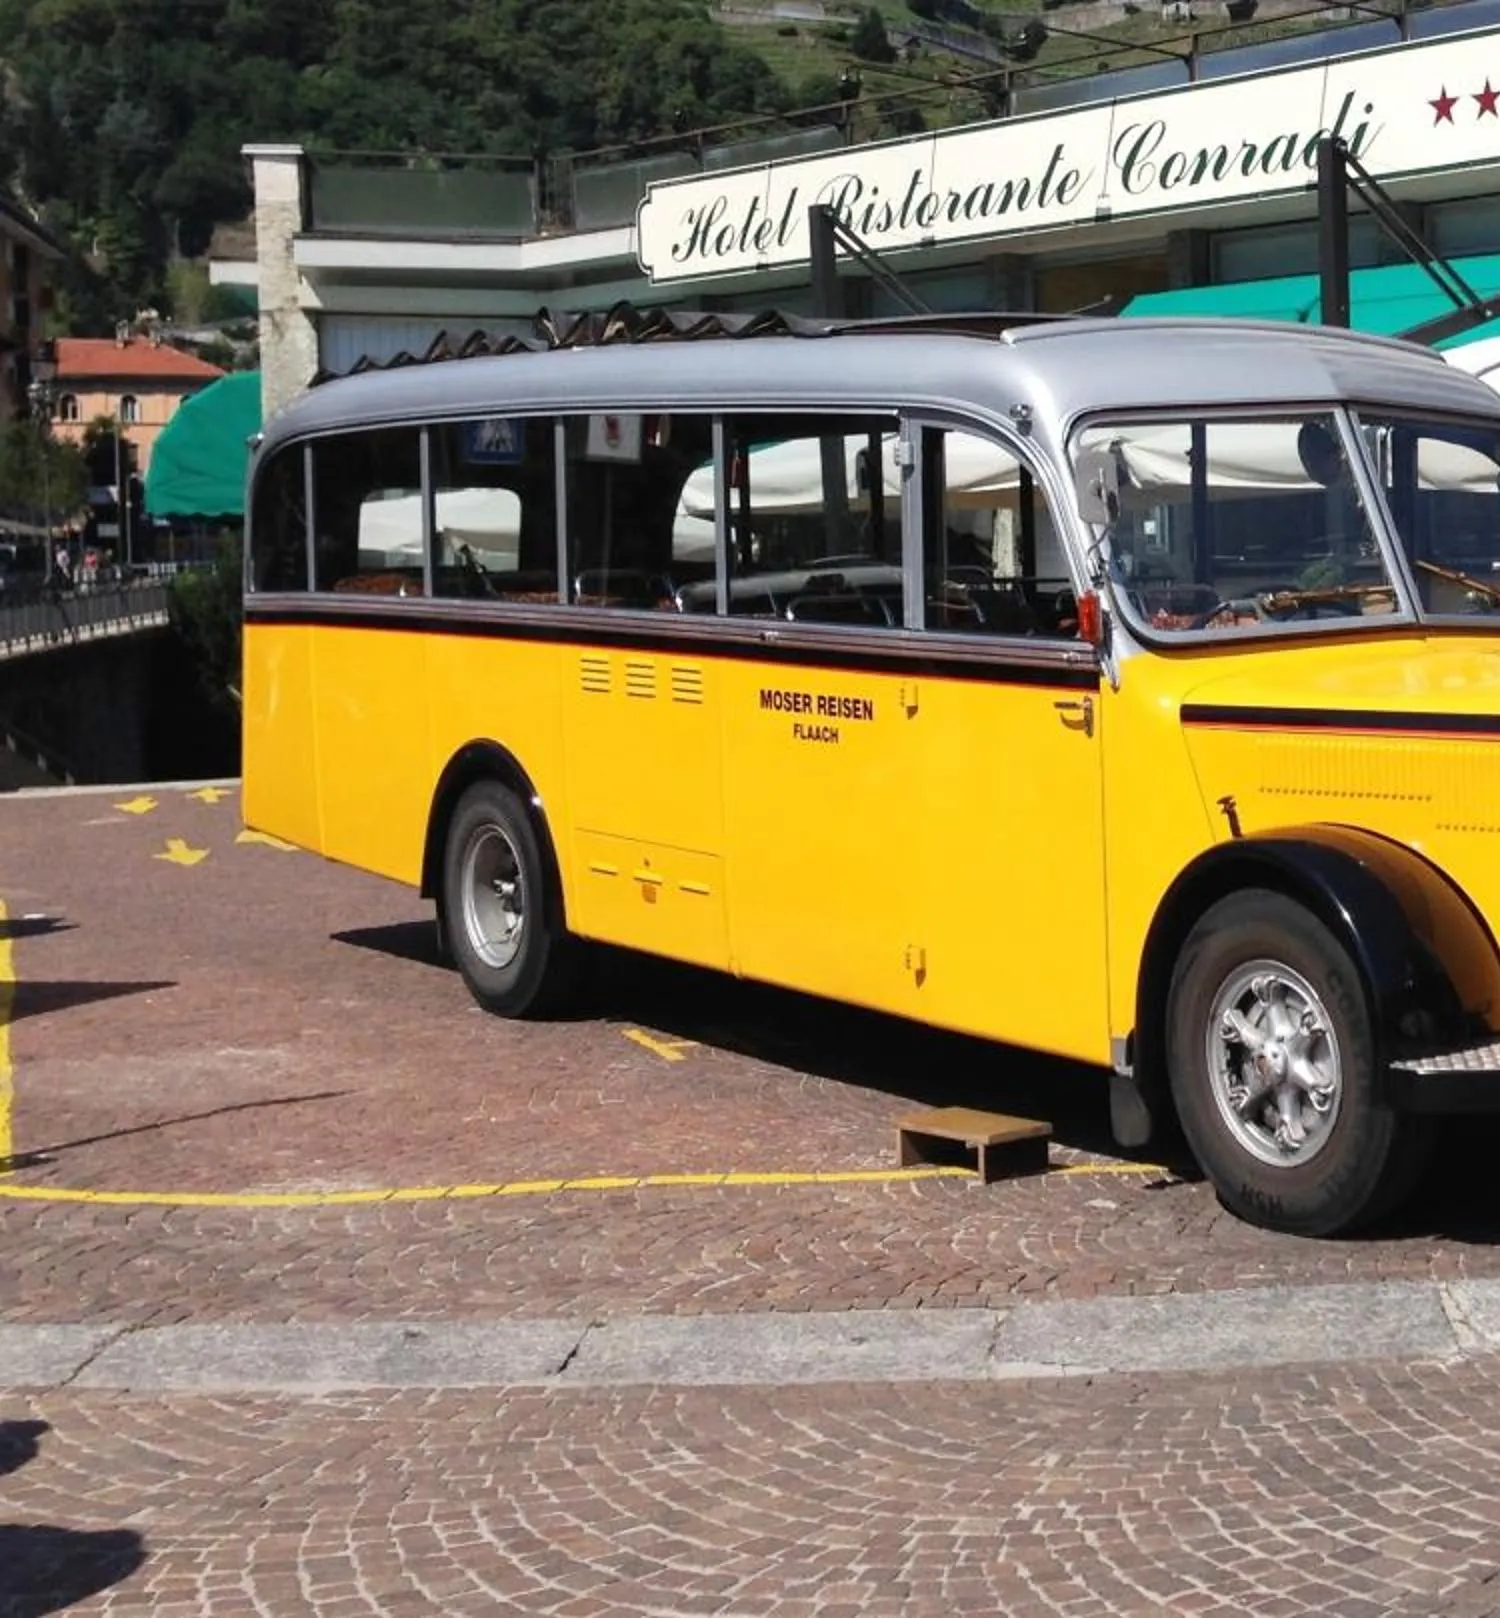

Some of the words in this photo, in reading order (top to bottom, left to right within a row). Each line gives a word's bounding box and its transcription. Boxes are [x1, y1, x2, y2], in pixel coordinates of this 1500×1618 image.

[671, 186, 799, 262] Hotel
[816, 143, 1096, 236] Ristorante
[759, 688, 813, 714] MOSER
[817, 695, 874, 721] REISEN
[793, 723, 840, 744] FLAACH
